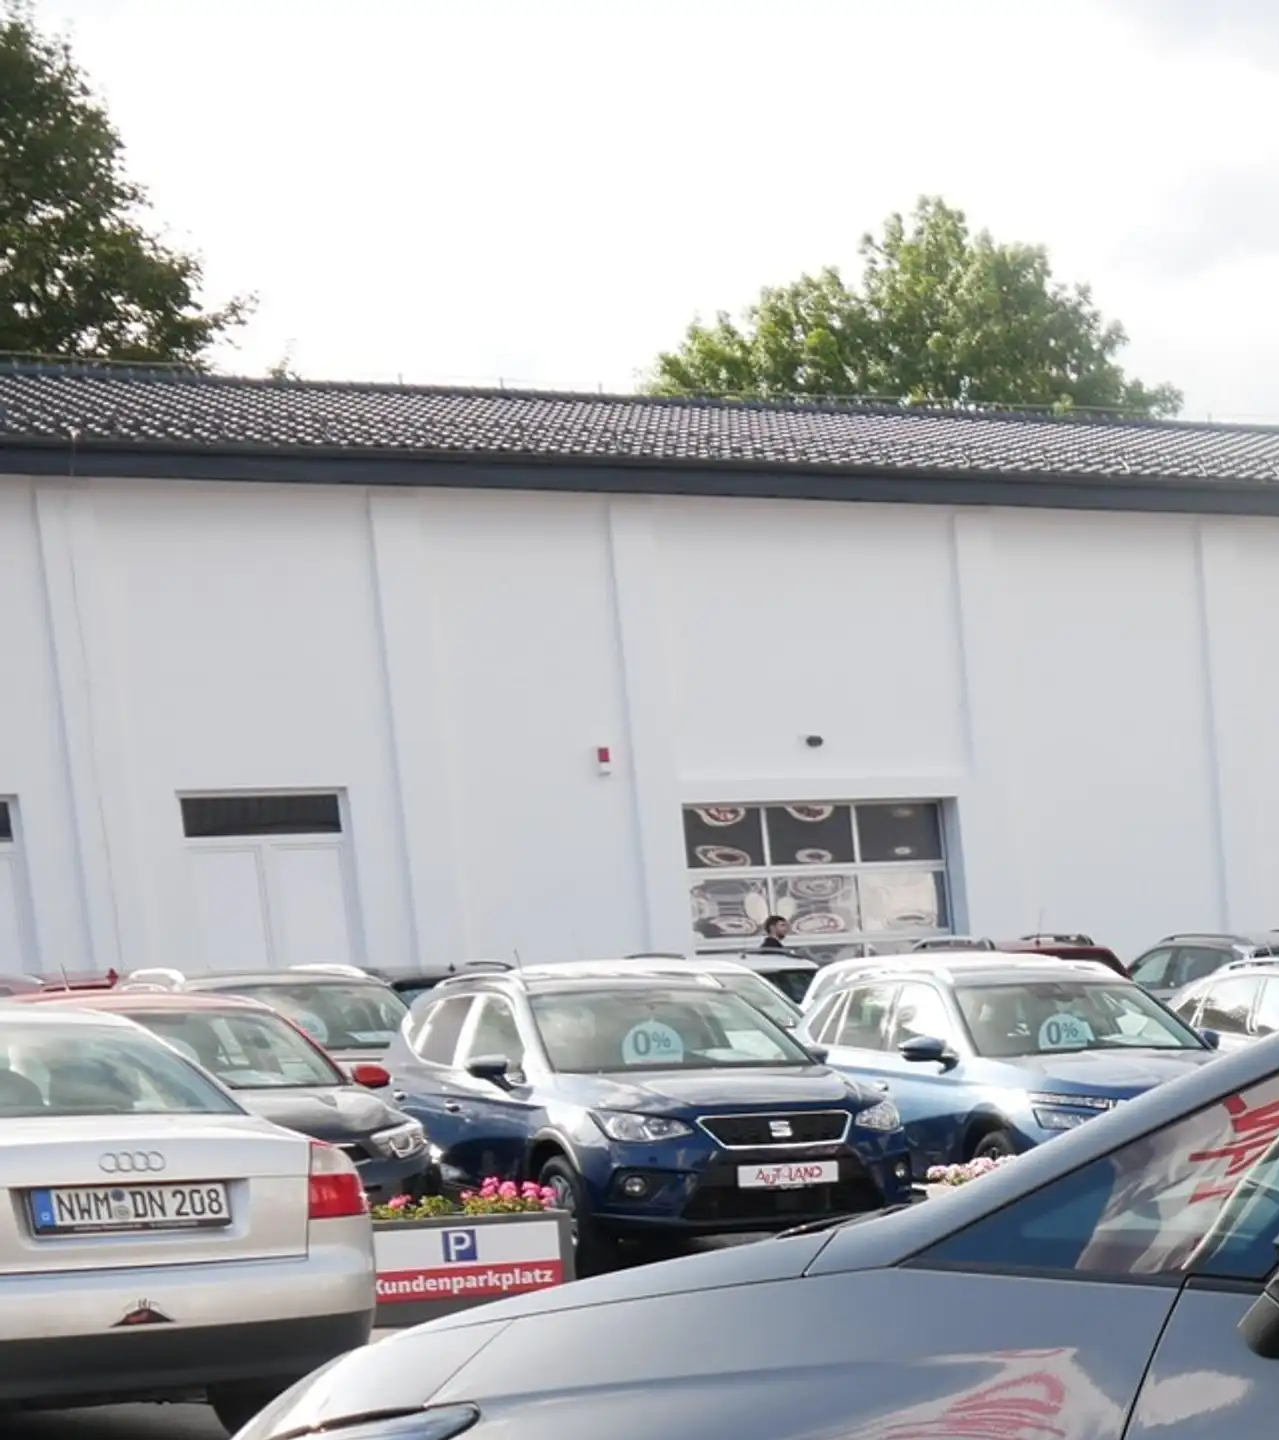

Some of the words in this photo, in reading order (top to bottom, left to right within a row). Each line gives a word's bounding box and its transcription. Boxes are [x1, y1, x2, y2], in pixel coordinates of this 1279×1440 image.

[633, 1030, 672, 1056] 0%
[1046, 1021, 1080, 1046] 0%
[56, 1191, 113, 1223] NWM
[128, 1190, 168, 1219] DN
[171, 1187, 224, 1217] 208
[449, 1231, 472, 1261] P
[375, 1268, 554, 1296] Kundenparkplatz
